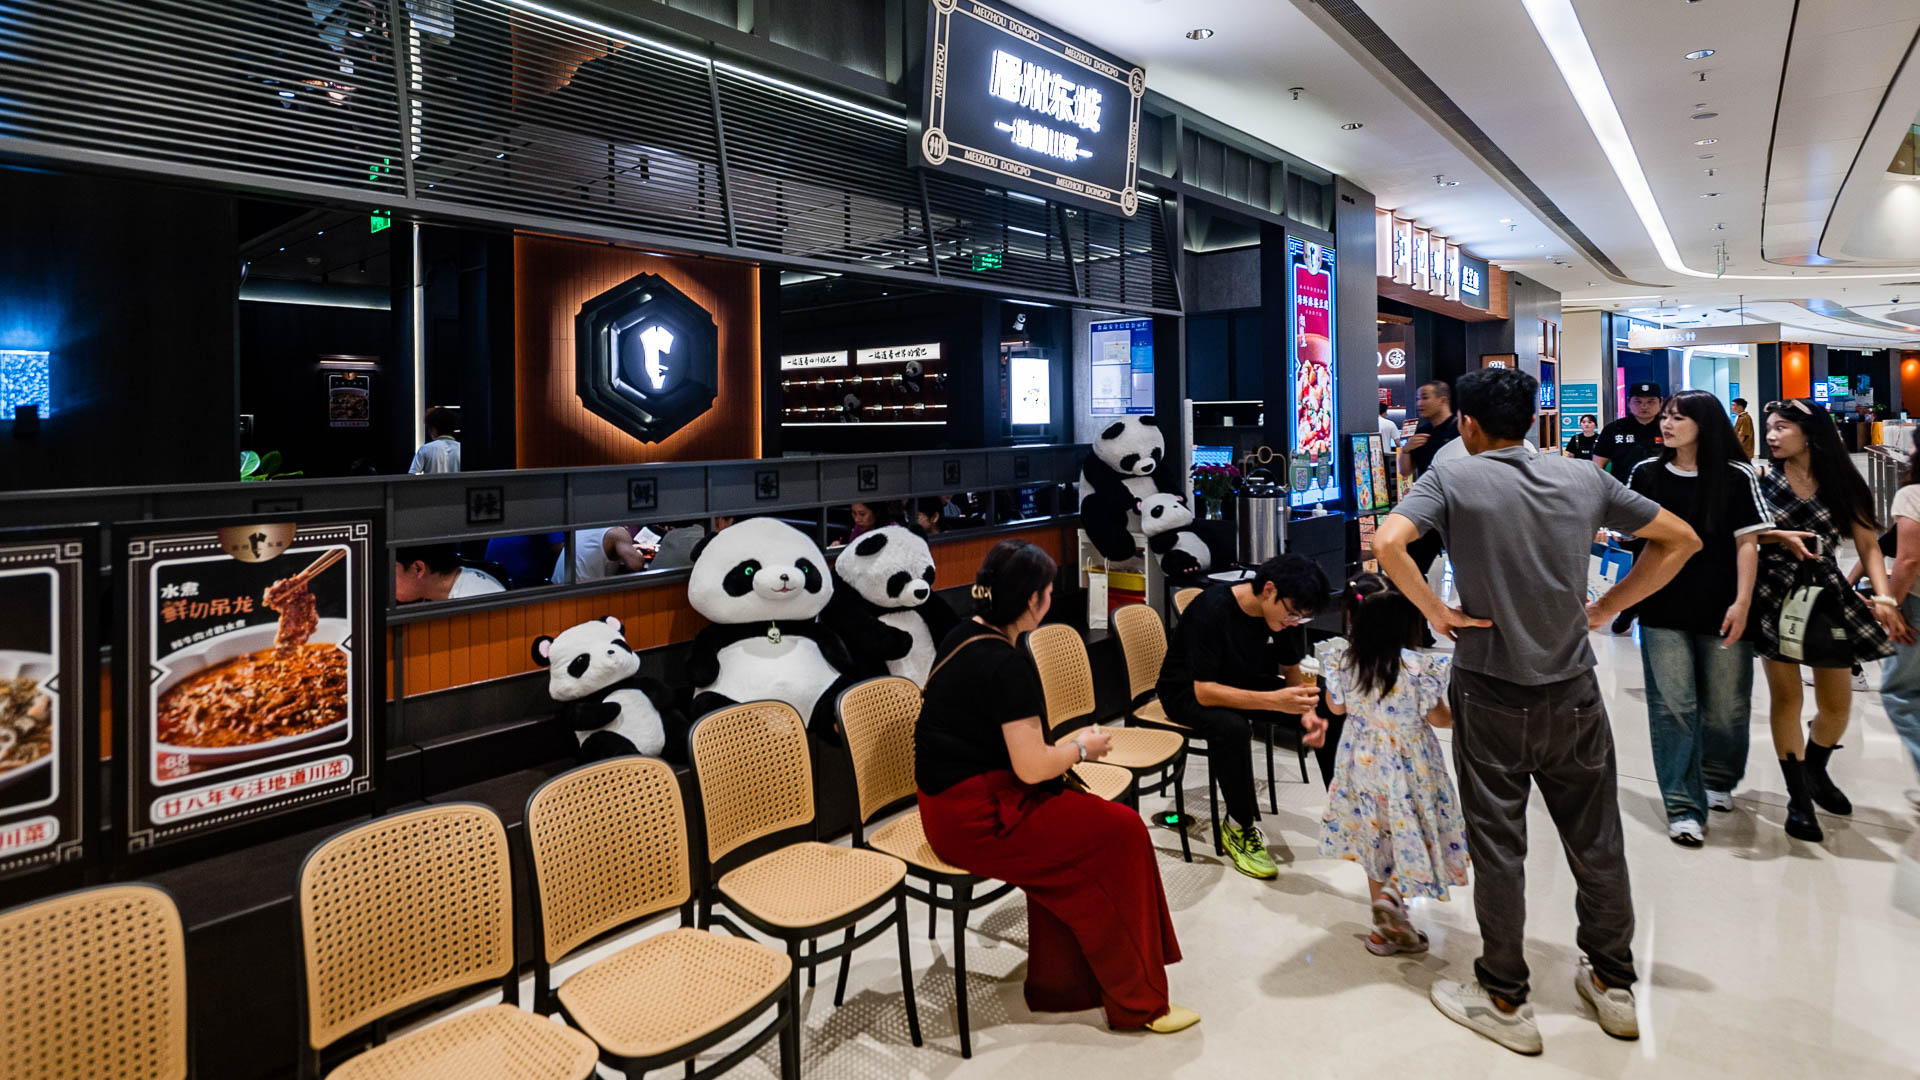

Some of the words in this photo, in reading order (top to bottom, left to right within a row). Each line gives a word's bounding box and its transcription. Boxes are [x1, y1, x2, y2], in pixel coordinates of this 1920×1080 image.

[972, 4, 1007, 27] MEIZHOU
[1008, 20, 1040, 42] DONGPO
[934, 43, 946, 98] MEIZHOU
[1064, 46, 1092, 66] MEIZHOU
[1093, 59, 1119, 77] DONGPO
[989, 49, 1102, 134] 眉州东坡
[929, 136, 943, 157] 州
[963, 150, 998, 168] MEIZHOU
[999, 160, 1031, 177] DONGPO
[1055, 176, 1084, 193] MEIZHOU
[1085, 184, 1111, 200] DONGPO
[1614, 434, 1635, 444] 安保
[160, 581, 200, 599] 水煮
[160, 595, 255, 623] 鲜切吊龙
[163, 760, 344, 817] 廿八年专注地道川菜
